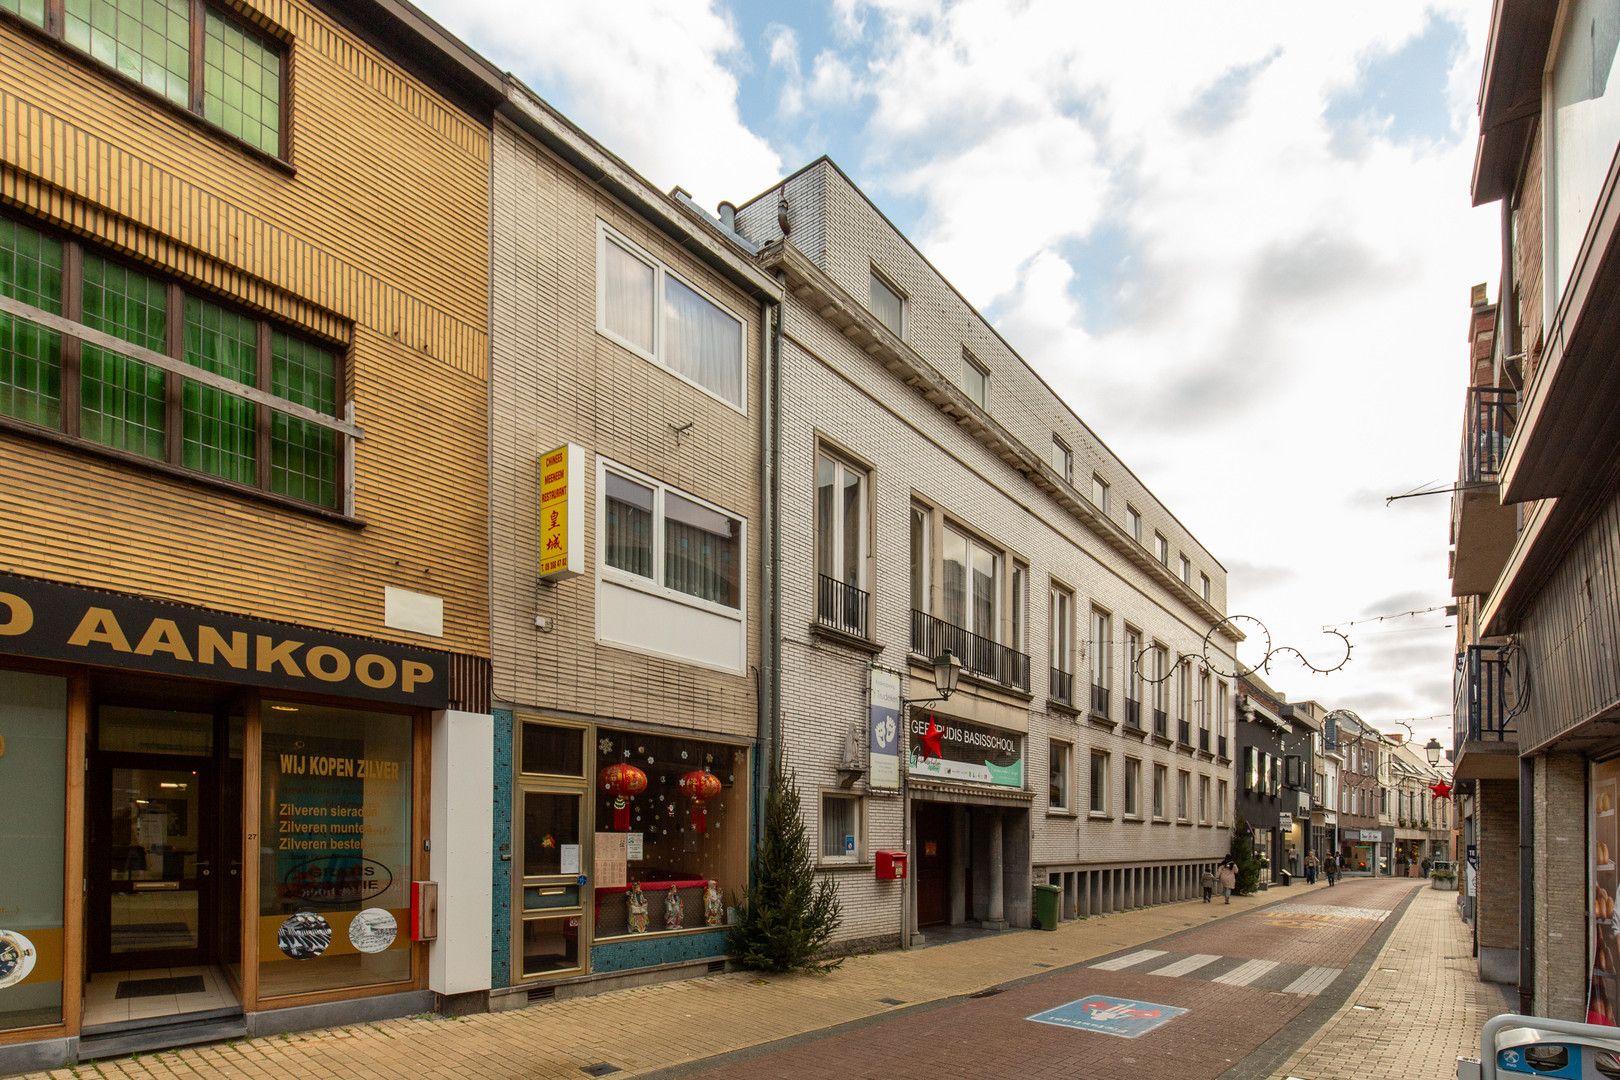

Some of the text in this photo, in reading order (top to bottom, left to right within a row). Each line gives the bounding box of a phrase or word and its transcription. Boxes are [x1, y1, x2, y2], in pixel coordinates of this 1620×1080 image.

[541, 485, 567, 503] RESTAURANT
[546, 510, 562, 550] 皇城
[67, 606, 434, 693] AANKOOP
[963, 730, 1016, 753] BASISSCHOOL
[280, 754, 400, 780] WIJ KOPEN ZILVER
[279, 803, 327, 817] Zilveren
[279, 820, 327, 834] Zilveren
[279, 837, 327, 850] Zilveren
